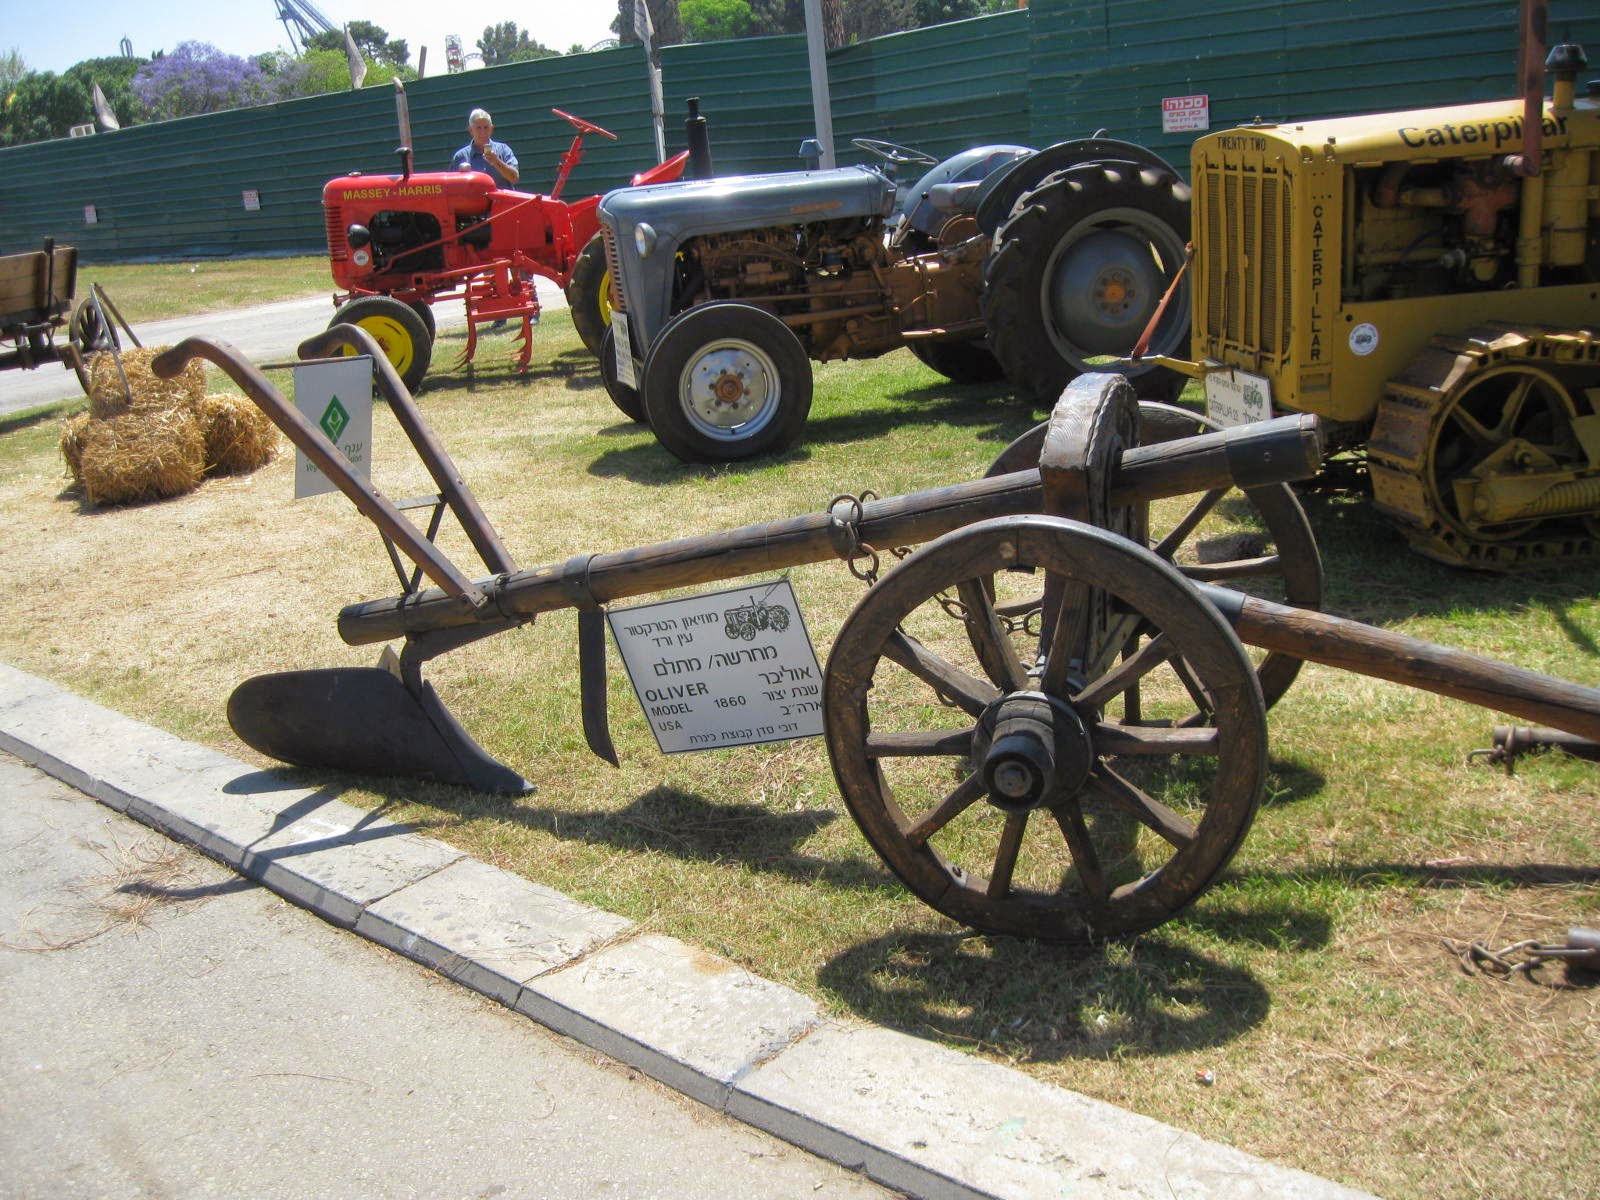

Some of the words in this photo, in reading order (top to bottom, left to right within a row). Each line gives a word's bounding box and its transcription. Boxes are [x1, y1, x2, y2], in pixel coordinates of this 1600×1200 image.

[1166, 97, 1203, 110] סכנה!
[1398, 114, 1568, 148] Caterpiar
[1217, 136, 1247, 151] TWENTY
[1250, 136, 1266, 151] TWO
[1311, 205, 1323, 360] CATERPILLAR
[681, 611, 719, 628] מוזיאון
[624, 619, 677, 638] הטרקטור
[652, 635, 674, 648] ורד
[676, 632, 694, 647] עין
[653, 657, 702, 677] מתלם
[758, 665, 813, 685] אוליבר
[645, 682, 710, 702] OLIVER
[762, 689, 788, 702] יצור
[792, 684, 819, 699] שנת
[652, 702, 693, 717] MODEL
[714, 695, 747, 709] 1860
[659, 719, 683, 731] USA
[757, 725, 775, 738] סדן
[778, 722, 799, 733] דובי
[689, 733, 717, 744] כינרת
[721, 728, 753, 740] קבוצת
